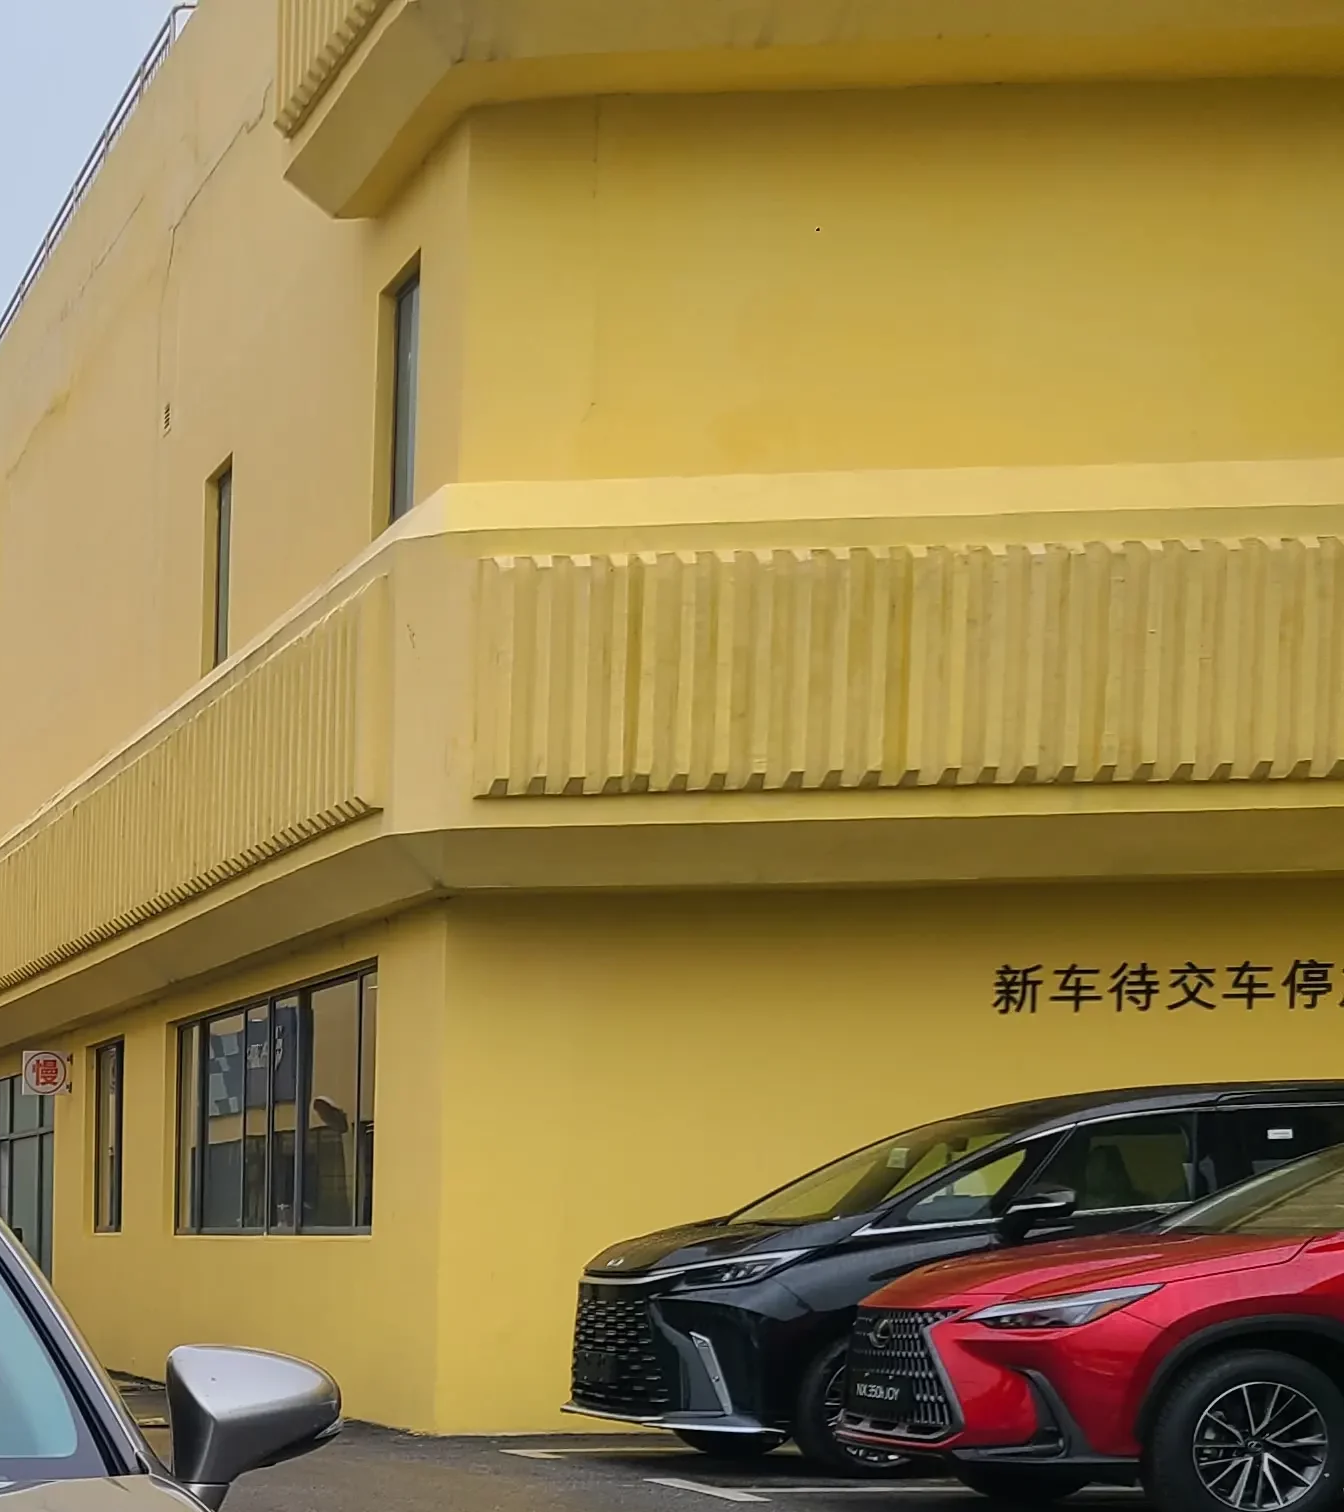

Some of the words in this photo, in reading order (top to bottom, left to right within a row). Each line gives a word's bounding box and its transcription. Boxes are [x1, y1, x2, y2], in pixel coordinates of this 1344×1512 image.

[992, 959, 1344, 1014] 新车待交车停
[32, 1059, 58, 1086] 慢
